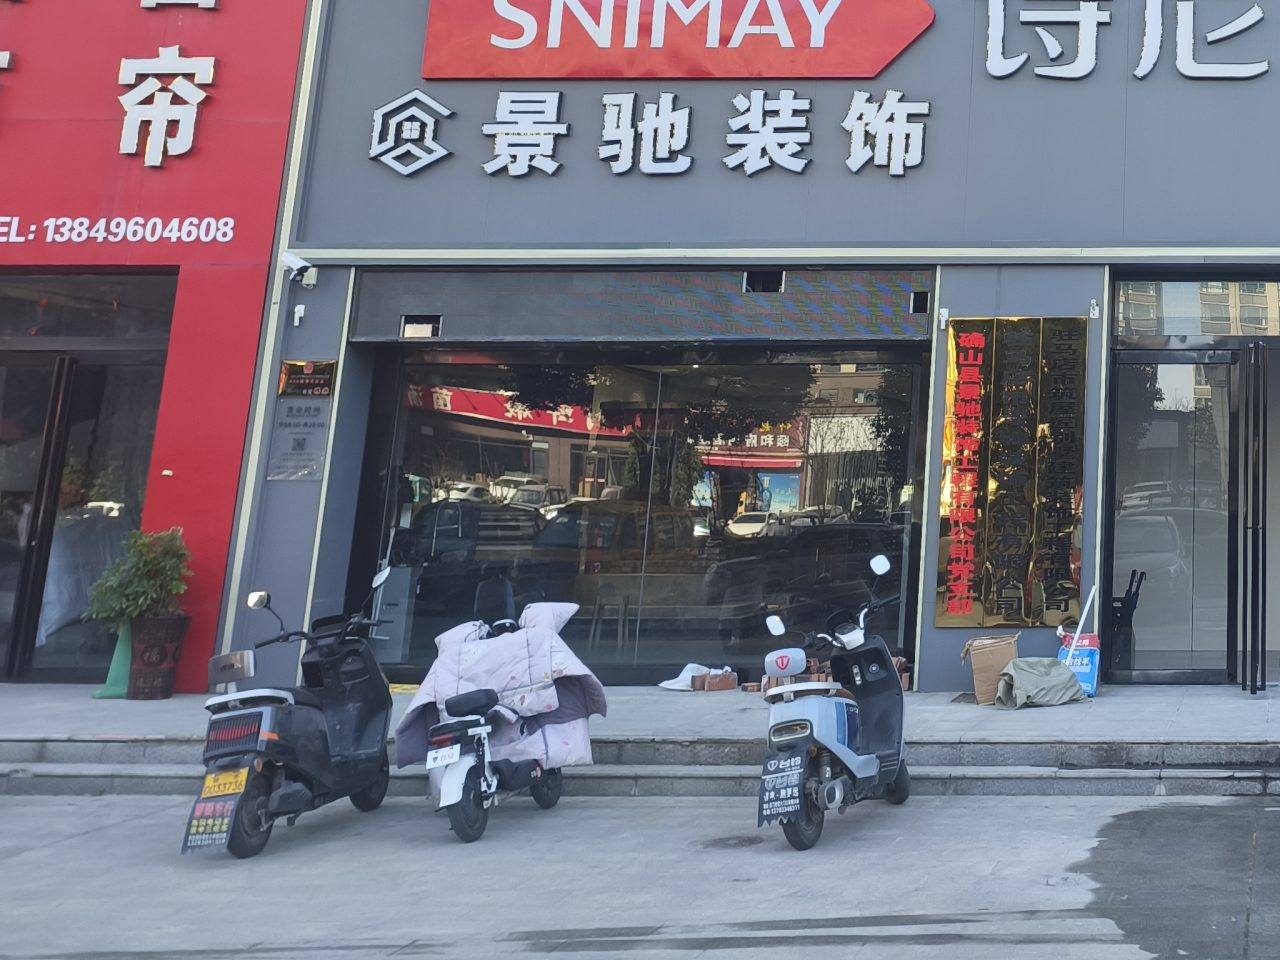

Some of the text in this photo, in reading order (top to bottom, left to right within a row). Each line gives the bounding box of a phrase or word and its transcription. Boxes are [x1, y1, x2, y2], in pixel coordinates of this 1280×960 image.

[481, 88, 932, 178] 景驰装饰
[43, 216, 236, 243] 13849604608
